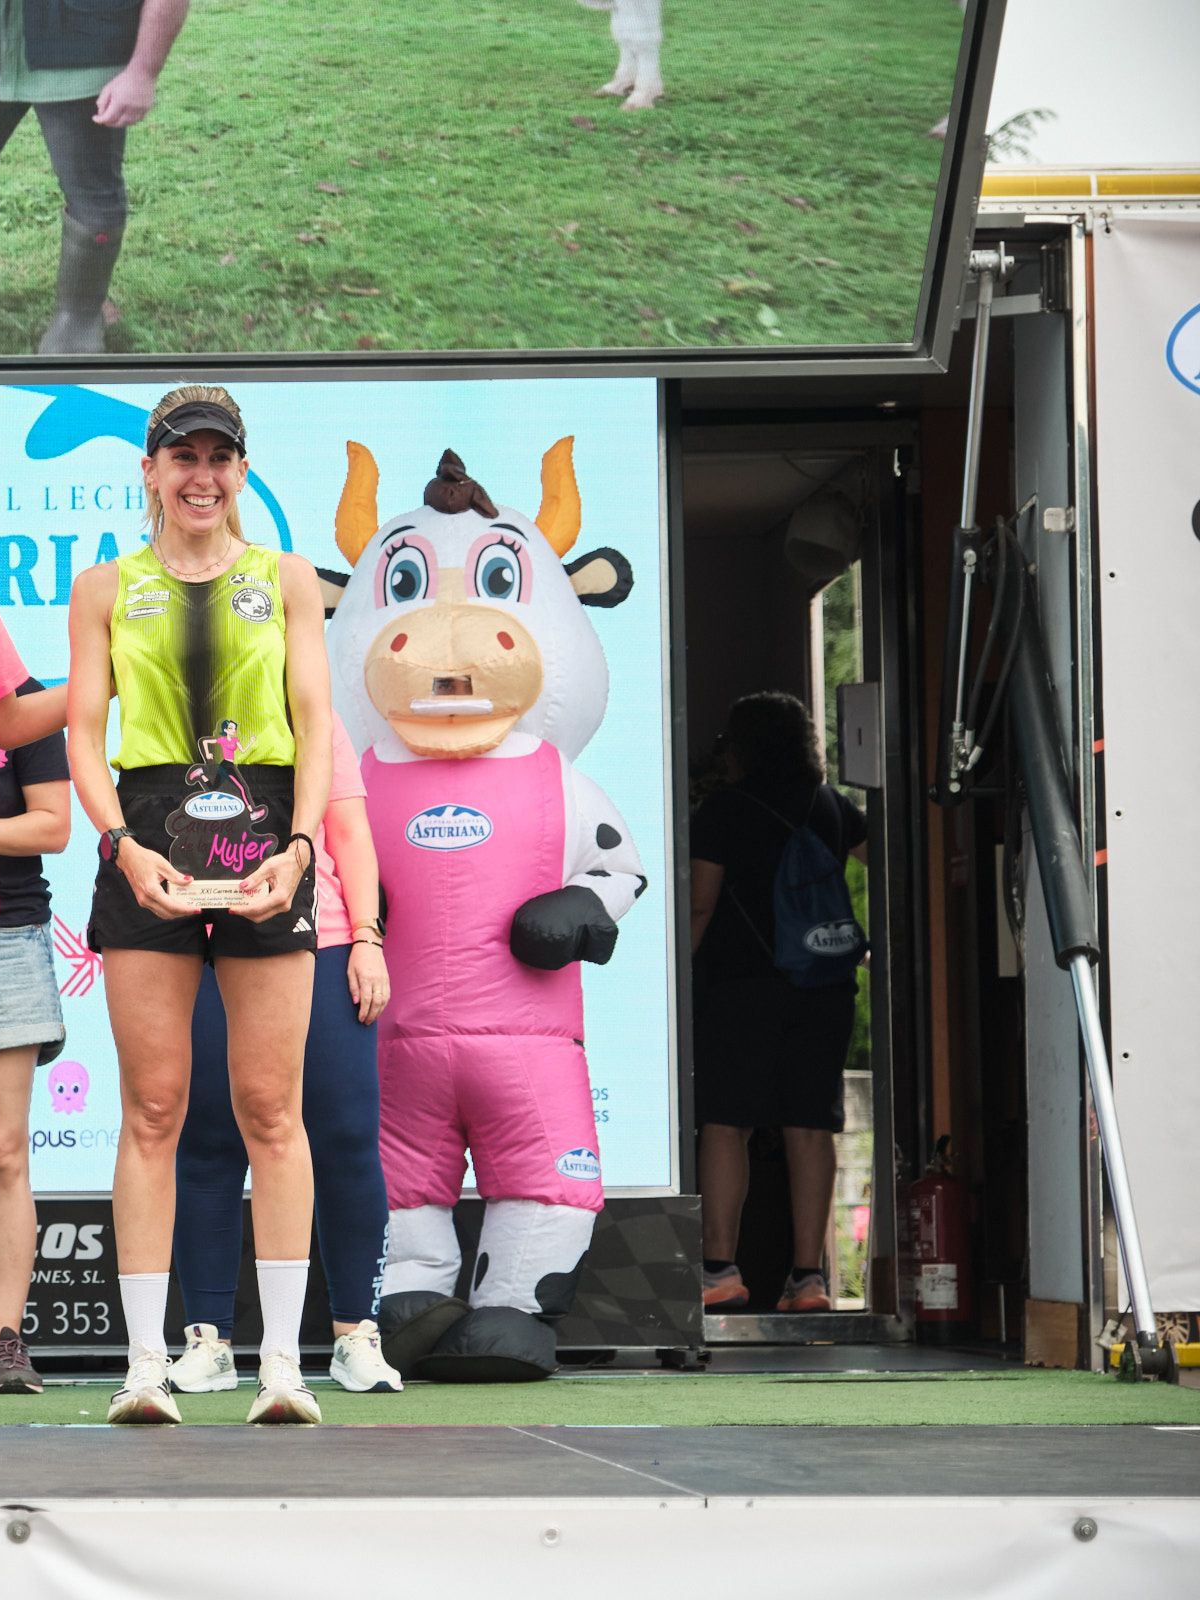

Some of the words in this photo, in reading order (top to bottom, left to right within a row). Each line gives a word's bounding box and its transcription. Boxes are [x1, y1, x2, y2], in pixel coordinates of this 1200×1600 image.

[191, 803, 239, 813] ASTURIANA
[412, 822, 486, 839] ASTURIANA
[206, 831, 273, 873] Mujer
[29, 1130, 77, 1154] pus
[81, 1270, 106, 1284] SL.
[52, 1301, 111, 1335] 353
